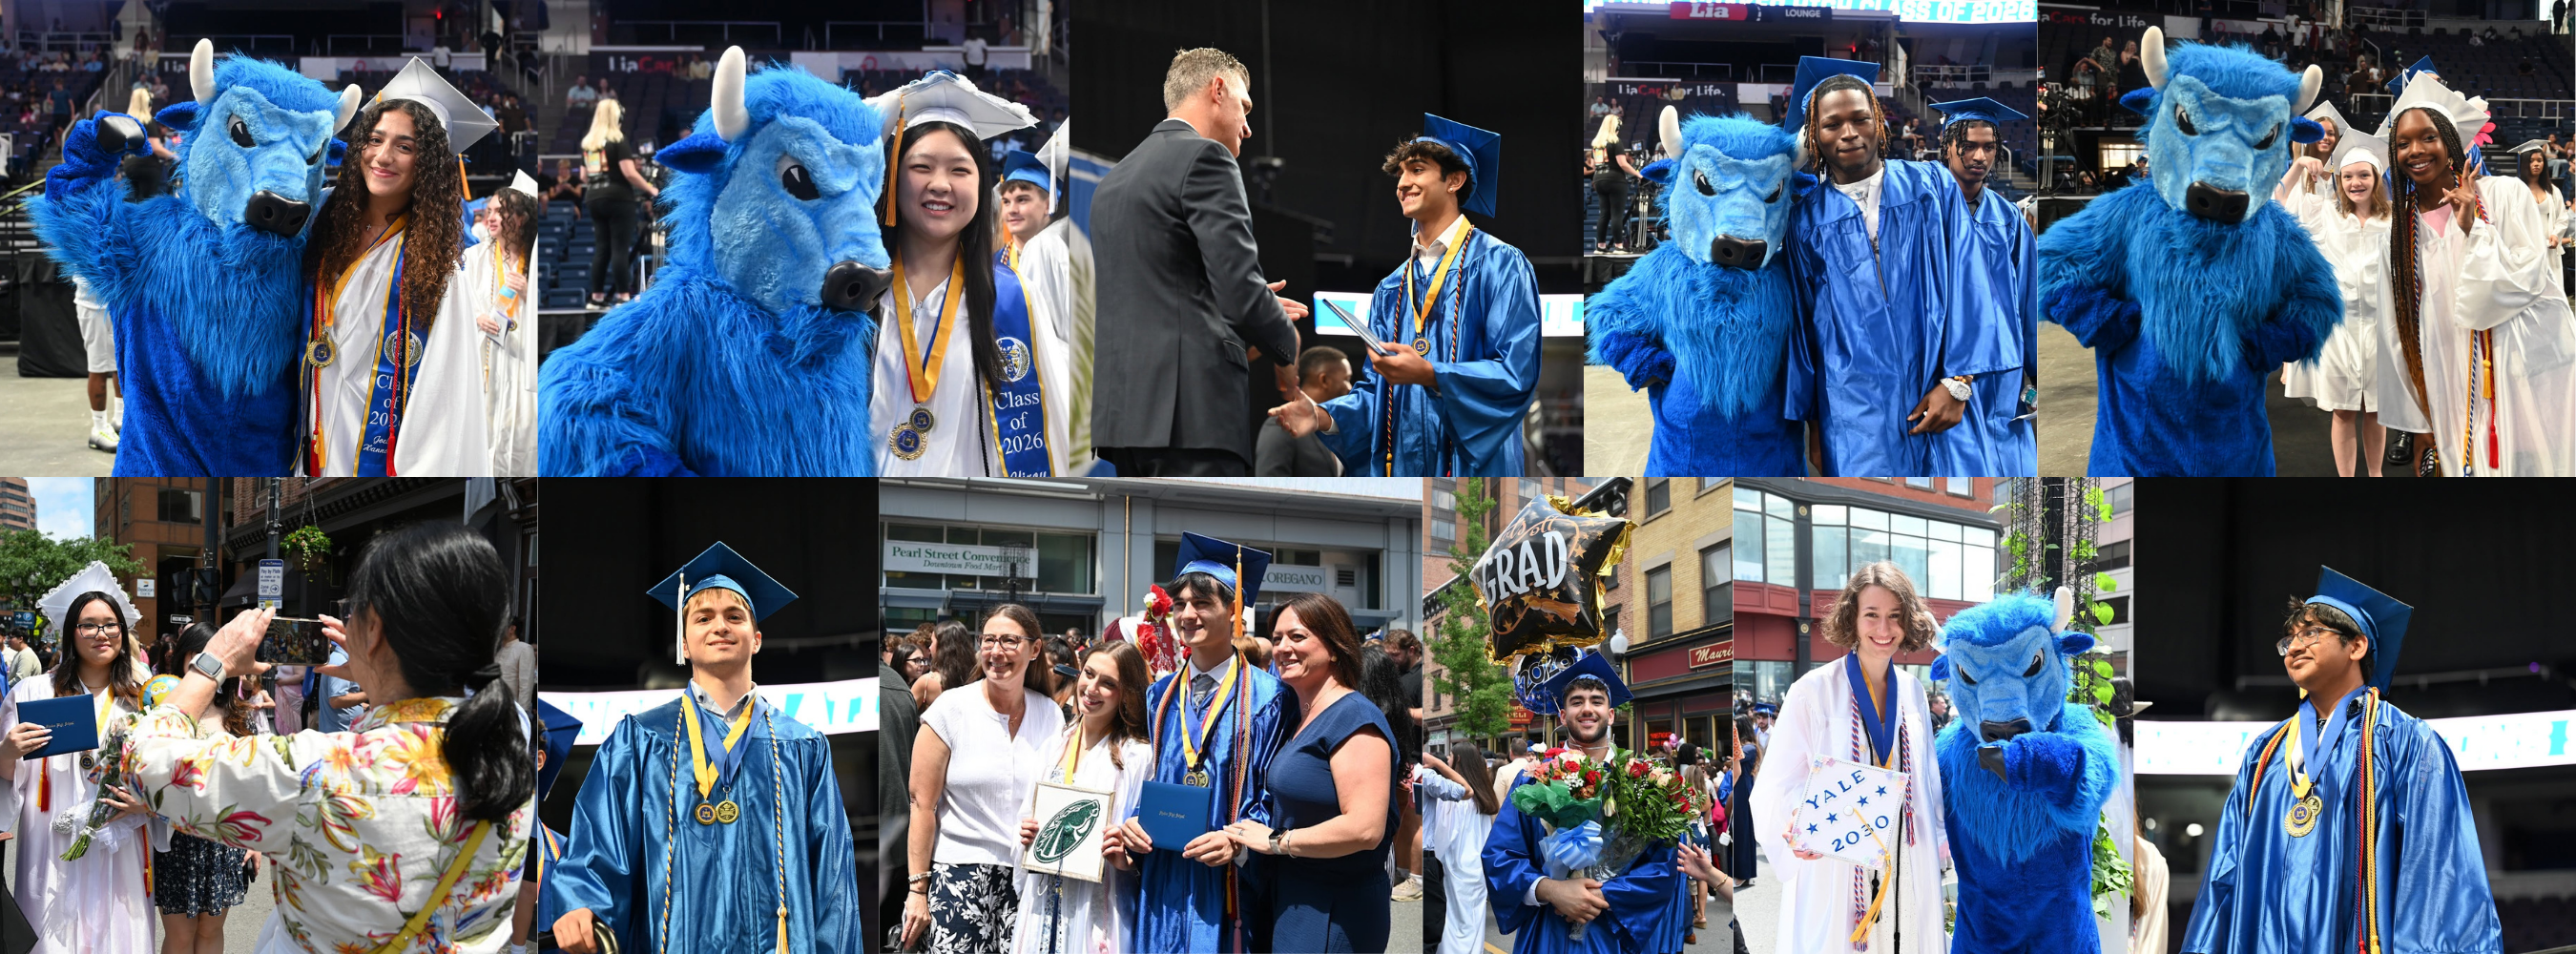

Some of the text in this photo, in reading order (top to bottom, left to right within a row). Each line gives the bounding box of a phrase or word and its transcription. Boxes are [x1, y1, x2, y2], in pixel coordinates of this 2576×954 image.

[1689, 3, 1729, 18] Lia
[1785, 9, 1821, 18] LOUNGE
[1936, 1, 1965, 21] OF
[1970, 1, 2035, 21] 2026
[2090, 12, 2113, 27] for
[608, 55, 675, 73] LiaCar
[1618, 84, 1662, 96] LiaCar
[376, 374, 415, 394] Clas
[384, 395, 401, 409] of
[995, 391, 1040, 410] Class
[369, 410, 401, 428] 202
[1009, 411, 1028, 430] of
[1003, 431, 1044, 455] 2026
[892, 546, 1030, 564] Pearl Street Convenience
[923, 559, 1002, 571] Downtown Food Mart
[1482, 530, 1567, 608] GRAD
[1266, 571, 1322, 586] OREGANO
[1695, 645, 1734, 662] Mauri
[1806, 770, 1865, 809] YALE
[1832, 816, 1889, 852] 2030
